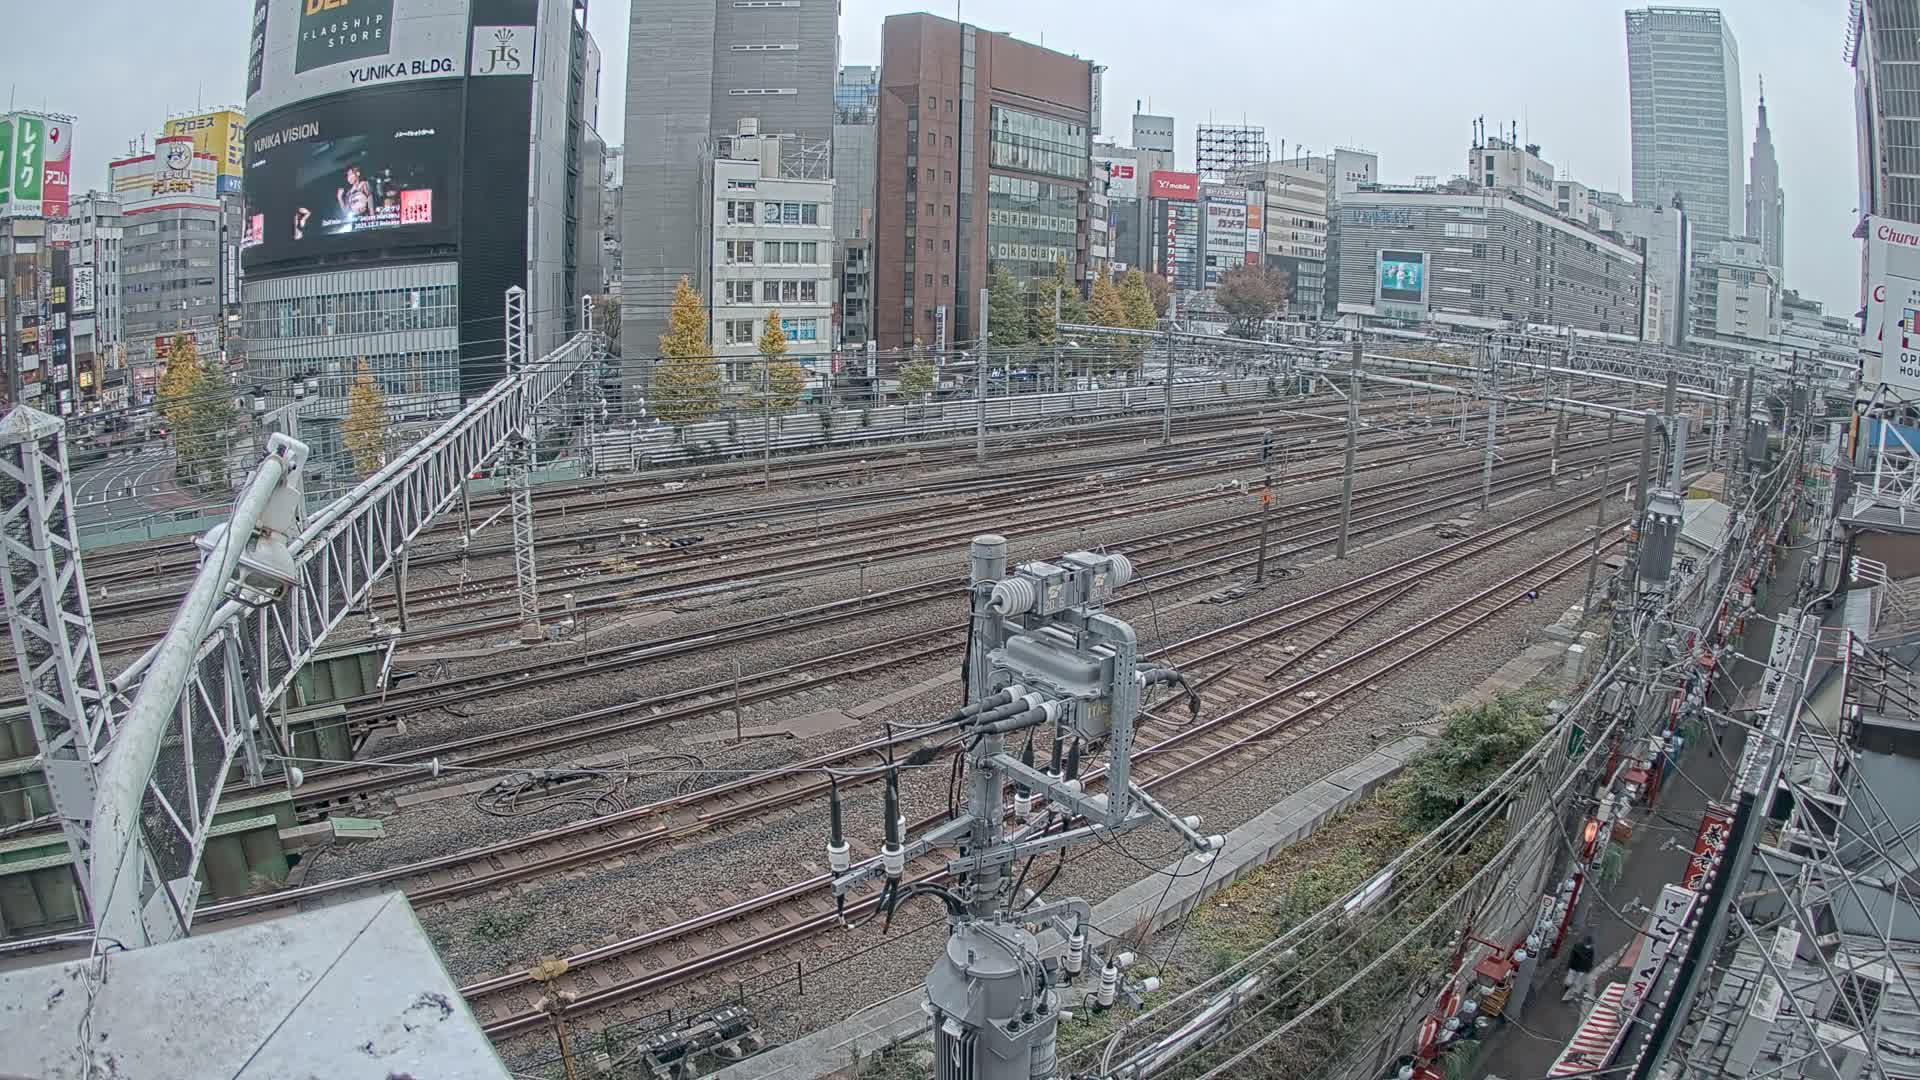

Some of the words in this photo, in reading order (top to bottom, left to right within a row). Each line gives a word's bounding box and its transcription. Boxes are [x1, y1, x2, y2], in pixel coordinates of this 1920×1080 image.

[303, 14, 383, 41] FLAGSHIP
[328, 28, 382, 48] STORE
[350, 61, 407, 84] YUNIKA
[411, 58, 456, 76] BLDG.
[175, 116, 214, 135] プロミス
[254, 132, 281, 153] YUNIKA
[282, 120, 319, 145] VISION
[20, 121, 37, 189] レイク
[45, 169, 68, 185] アコム
